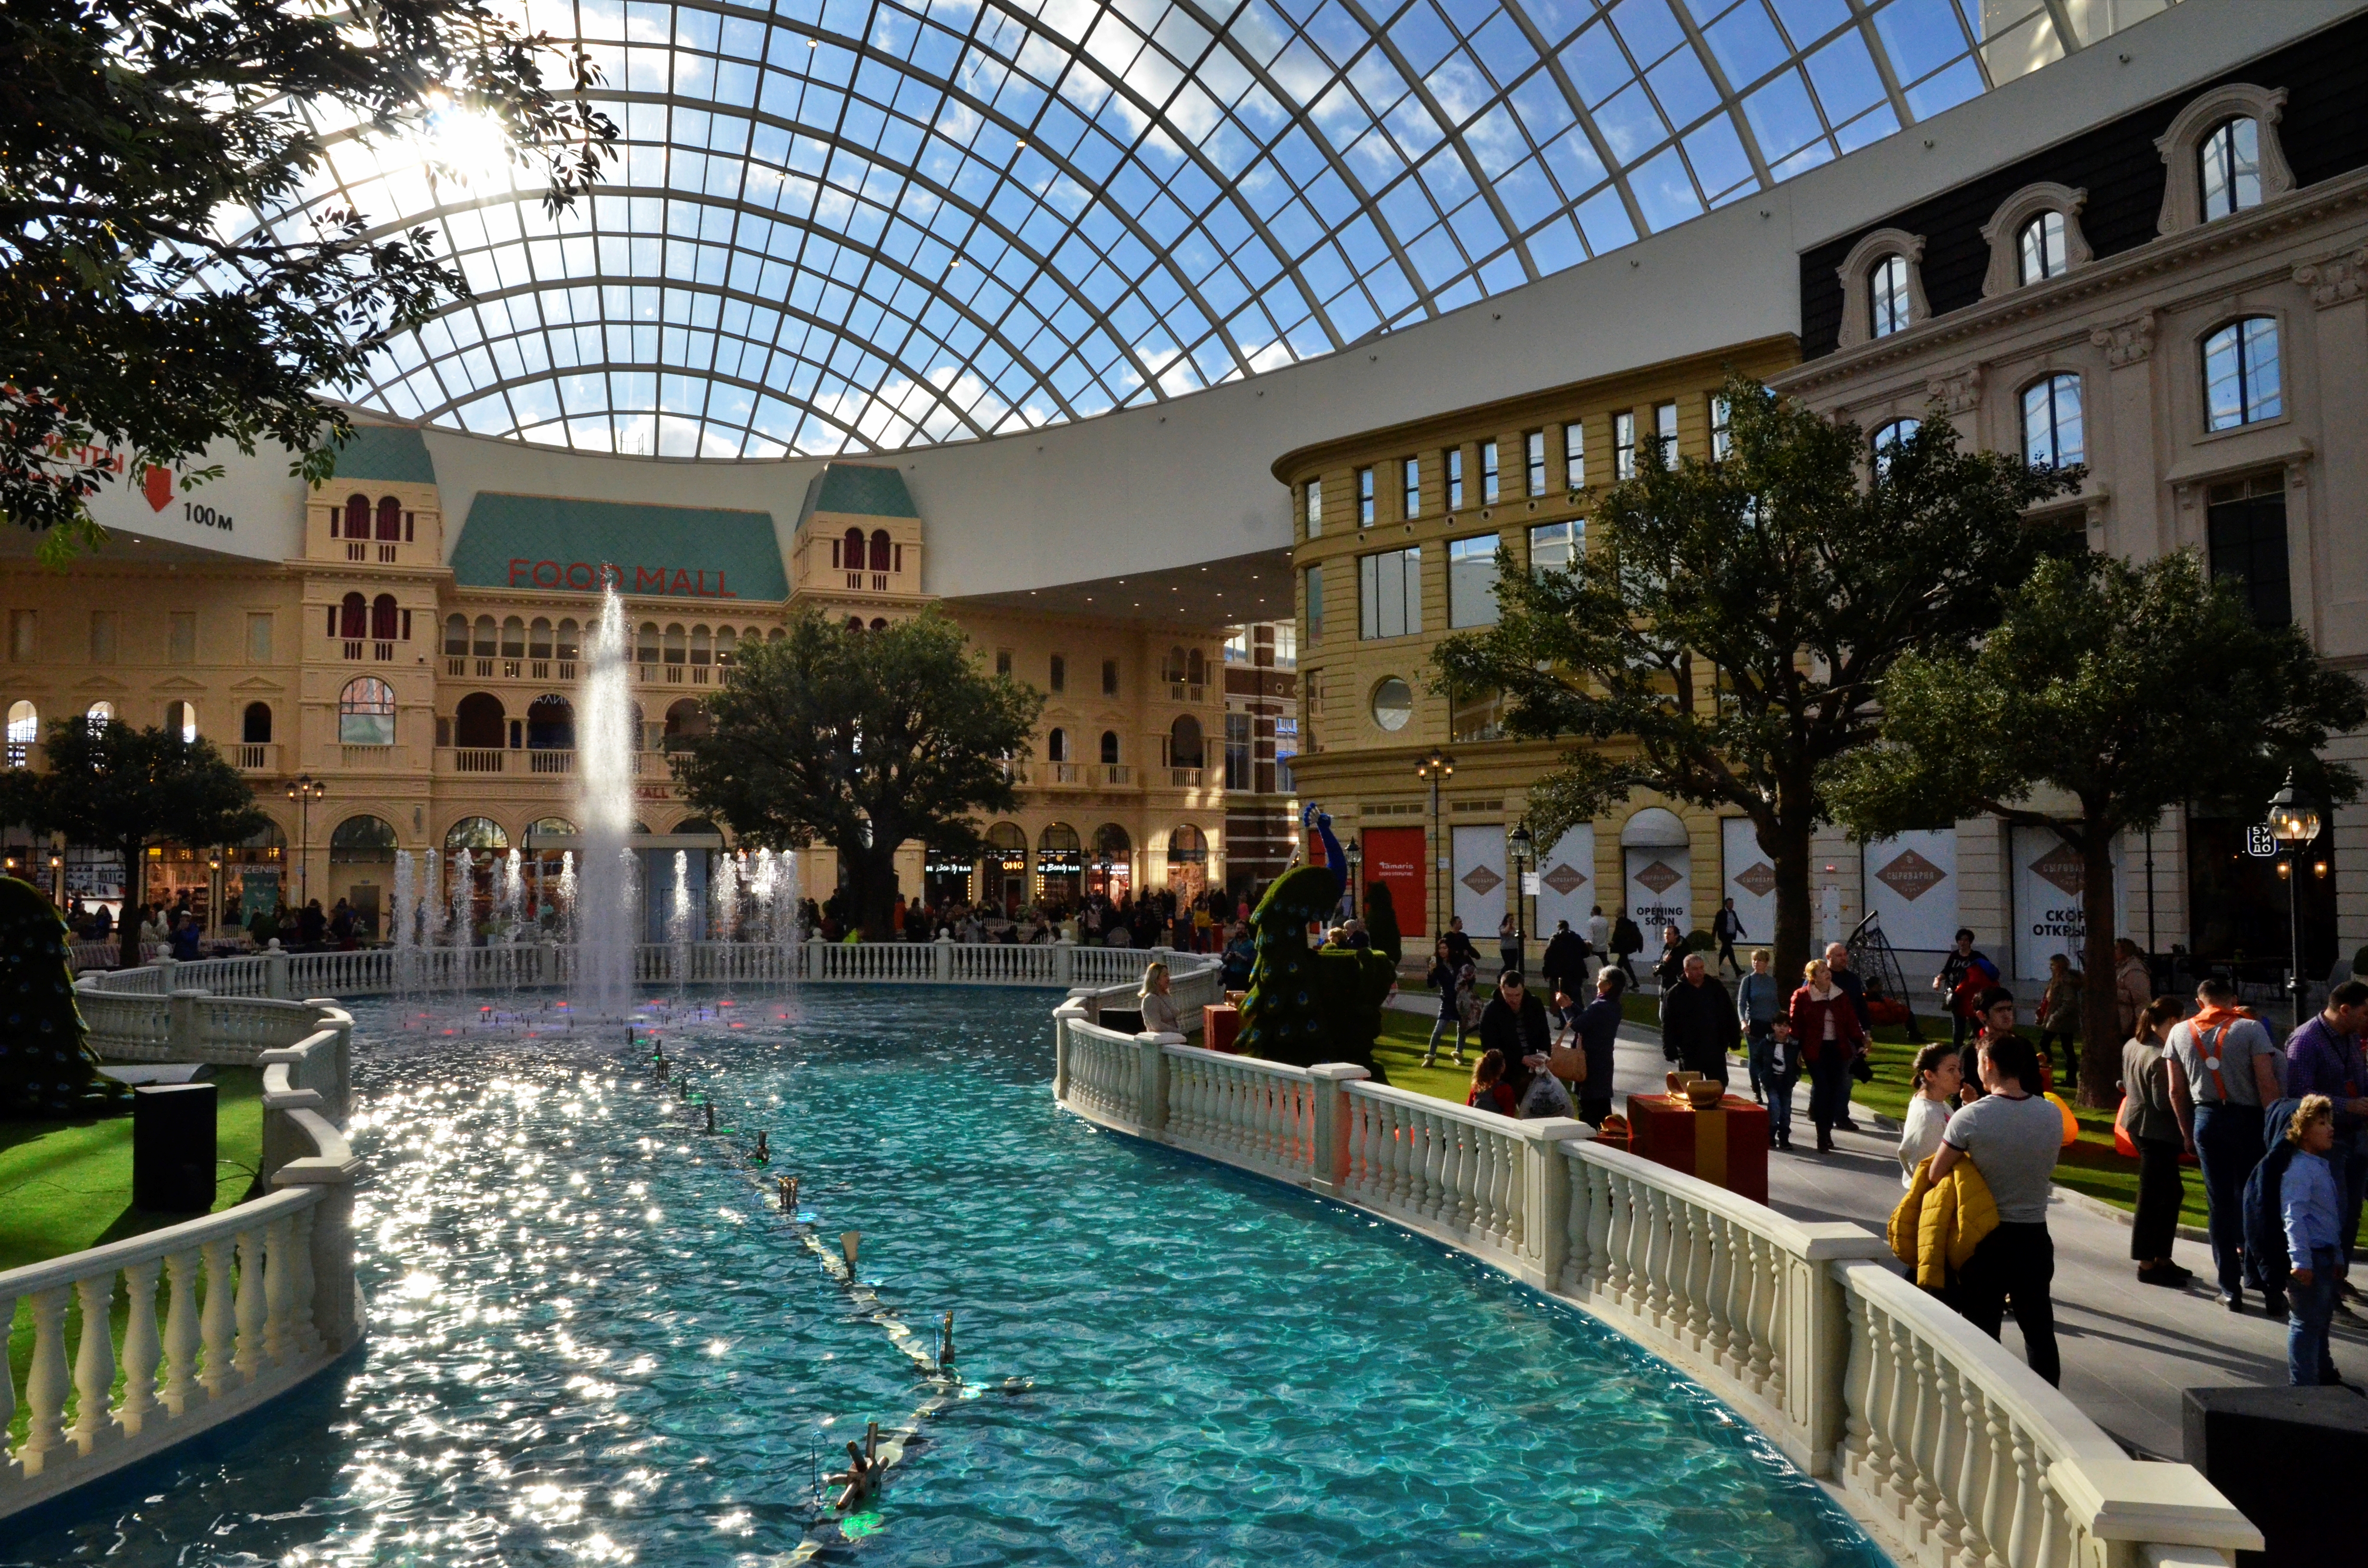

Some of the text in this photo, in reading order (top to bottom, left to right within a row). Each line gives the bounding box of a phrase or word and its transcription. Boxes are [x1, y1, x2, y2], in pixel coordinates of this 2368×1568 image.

[509, 559, 736, 597] FOOD MALL
[2253, 826, 2269, 835] БУ
[2252, 835, 2270, 844] СИ
[2253, 844, 2271, 853] ДО
[226, 865, 280, 874] TEZENIS
[1046, 863, 1067, 874] Beauty
[1887, 871, 1934, 880] СЫРОВАРНЯ
[1637, 907, 1683, 916] OPENING
[2046, 910, 2084, 922] СКОР
[1645, 917, 1675, 925] SOON
[2033, 924, 2085, 937] ОТКРЫ
